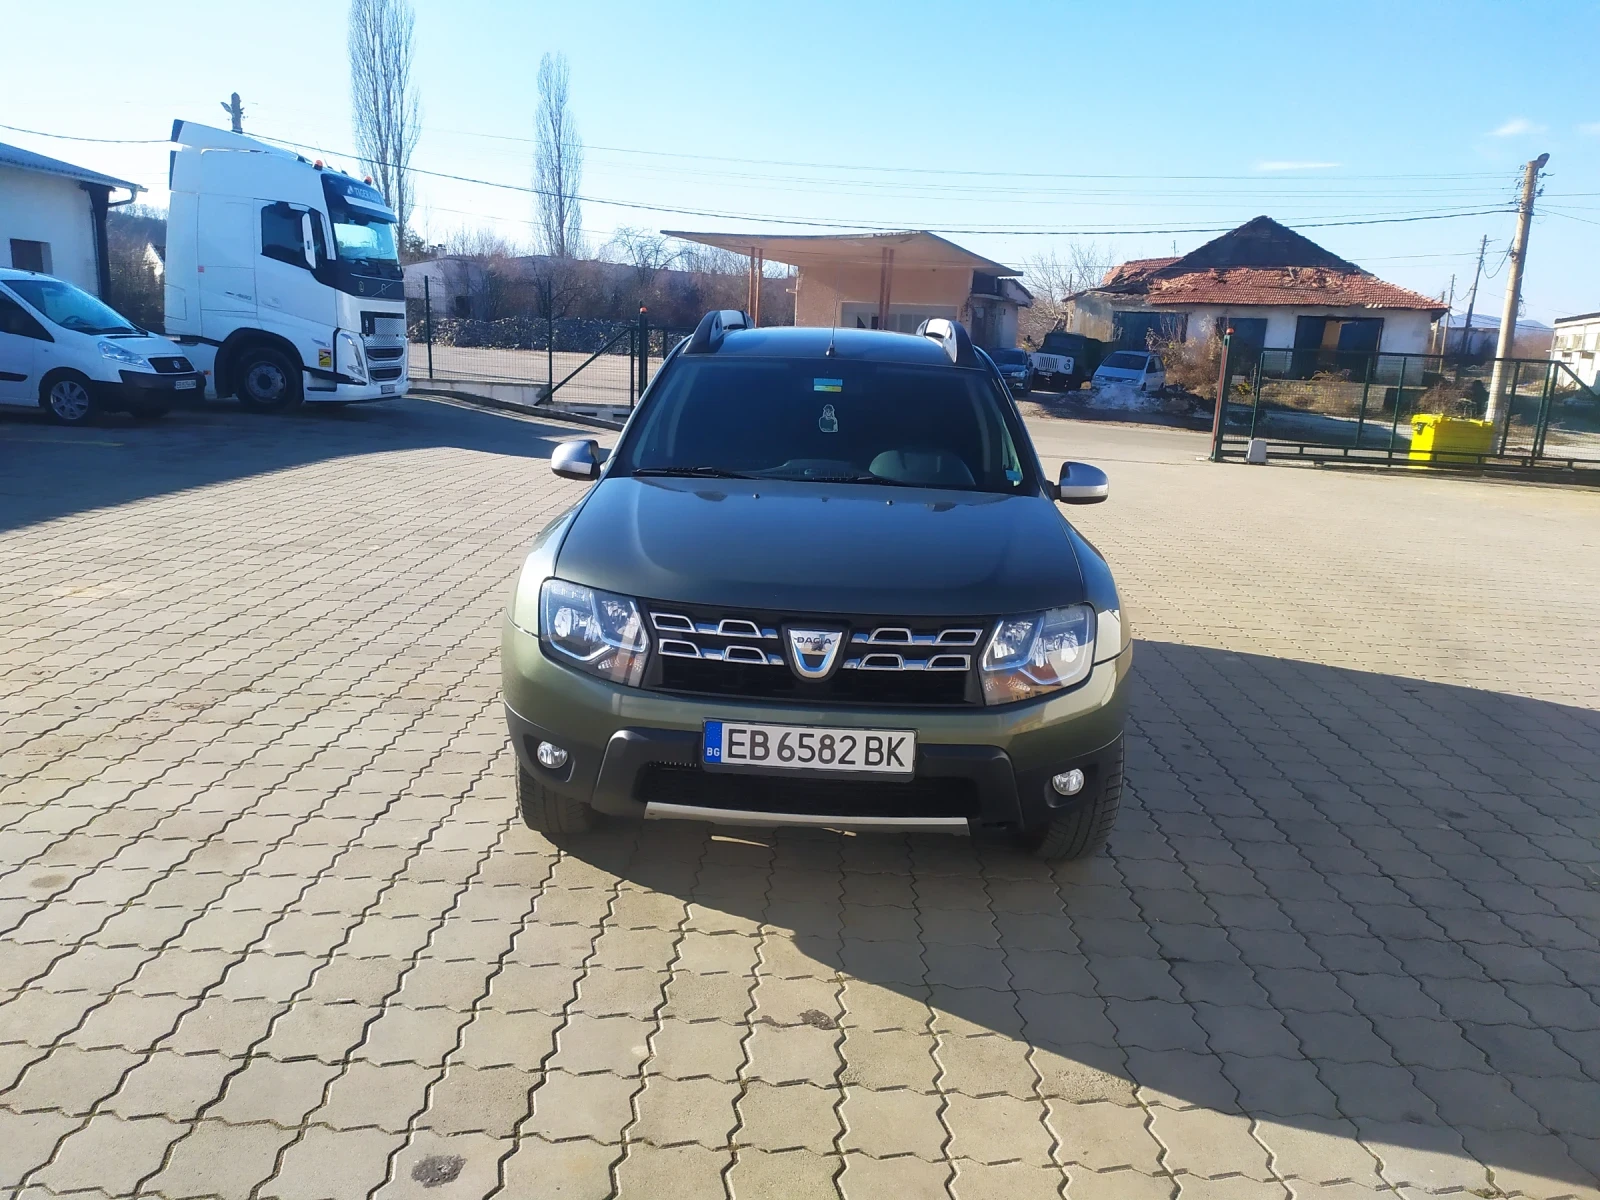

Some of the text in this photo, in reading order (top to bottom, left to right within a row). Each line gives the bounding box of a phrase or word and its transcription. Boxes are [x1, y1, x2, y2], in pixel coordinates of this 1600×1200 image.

[797, 637, 832, 645] DACIA
[706, 747, 720, 757] BG
[727, 728, 906, 767] EB 6582 BK
